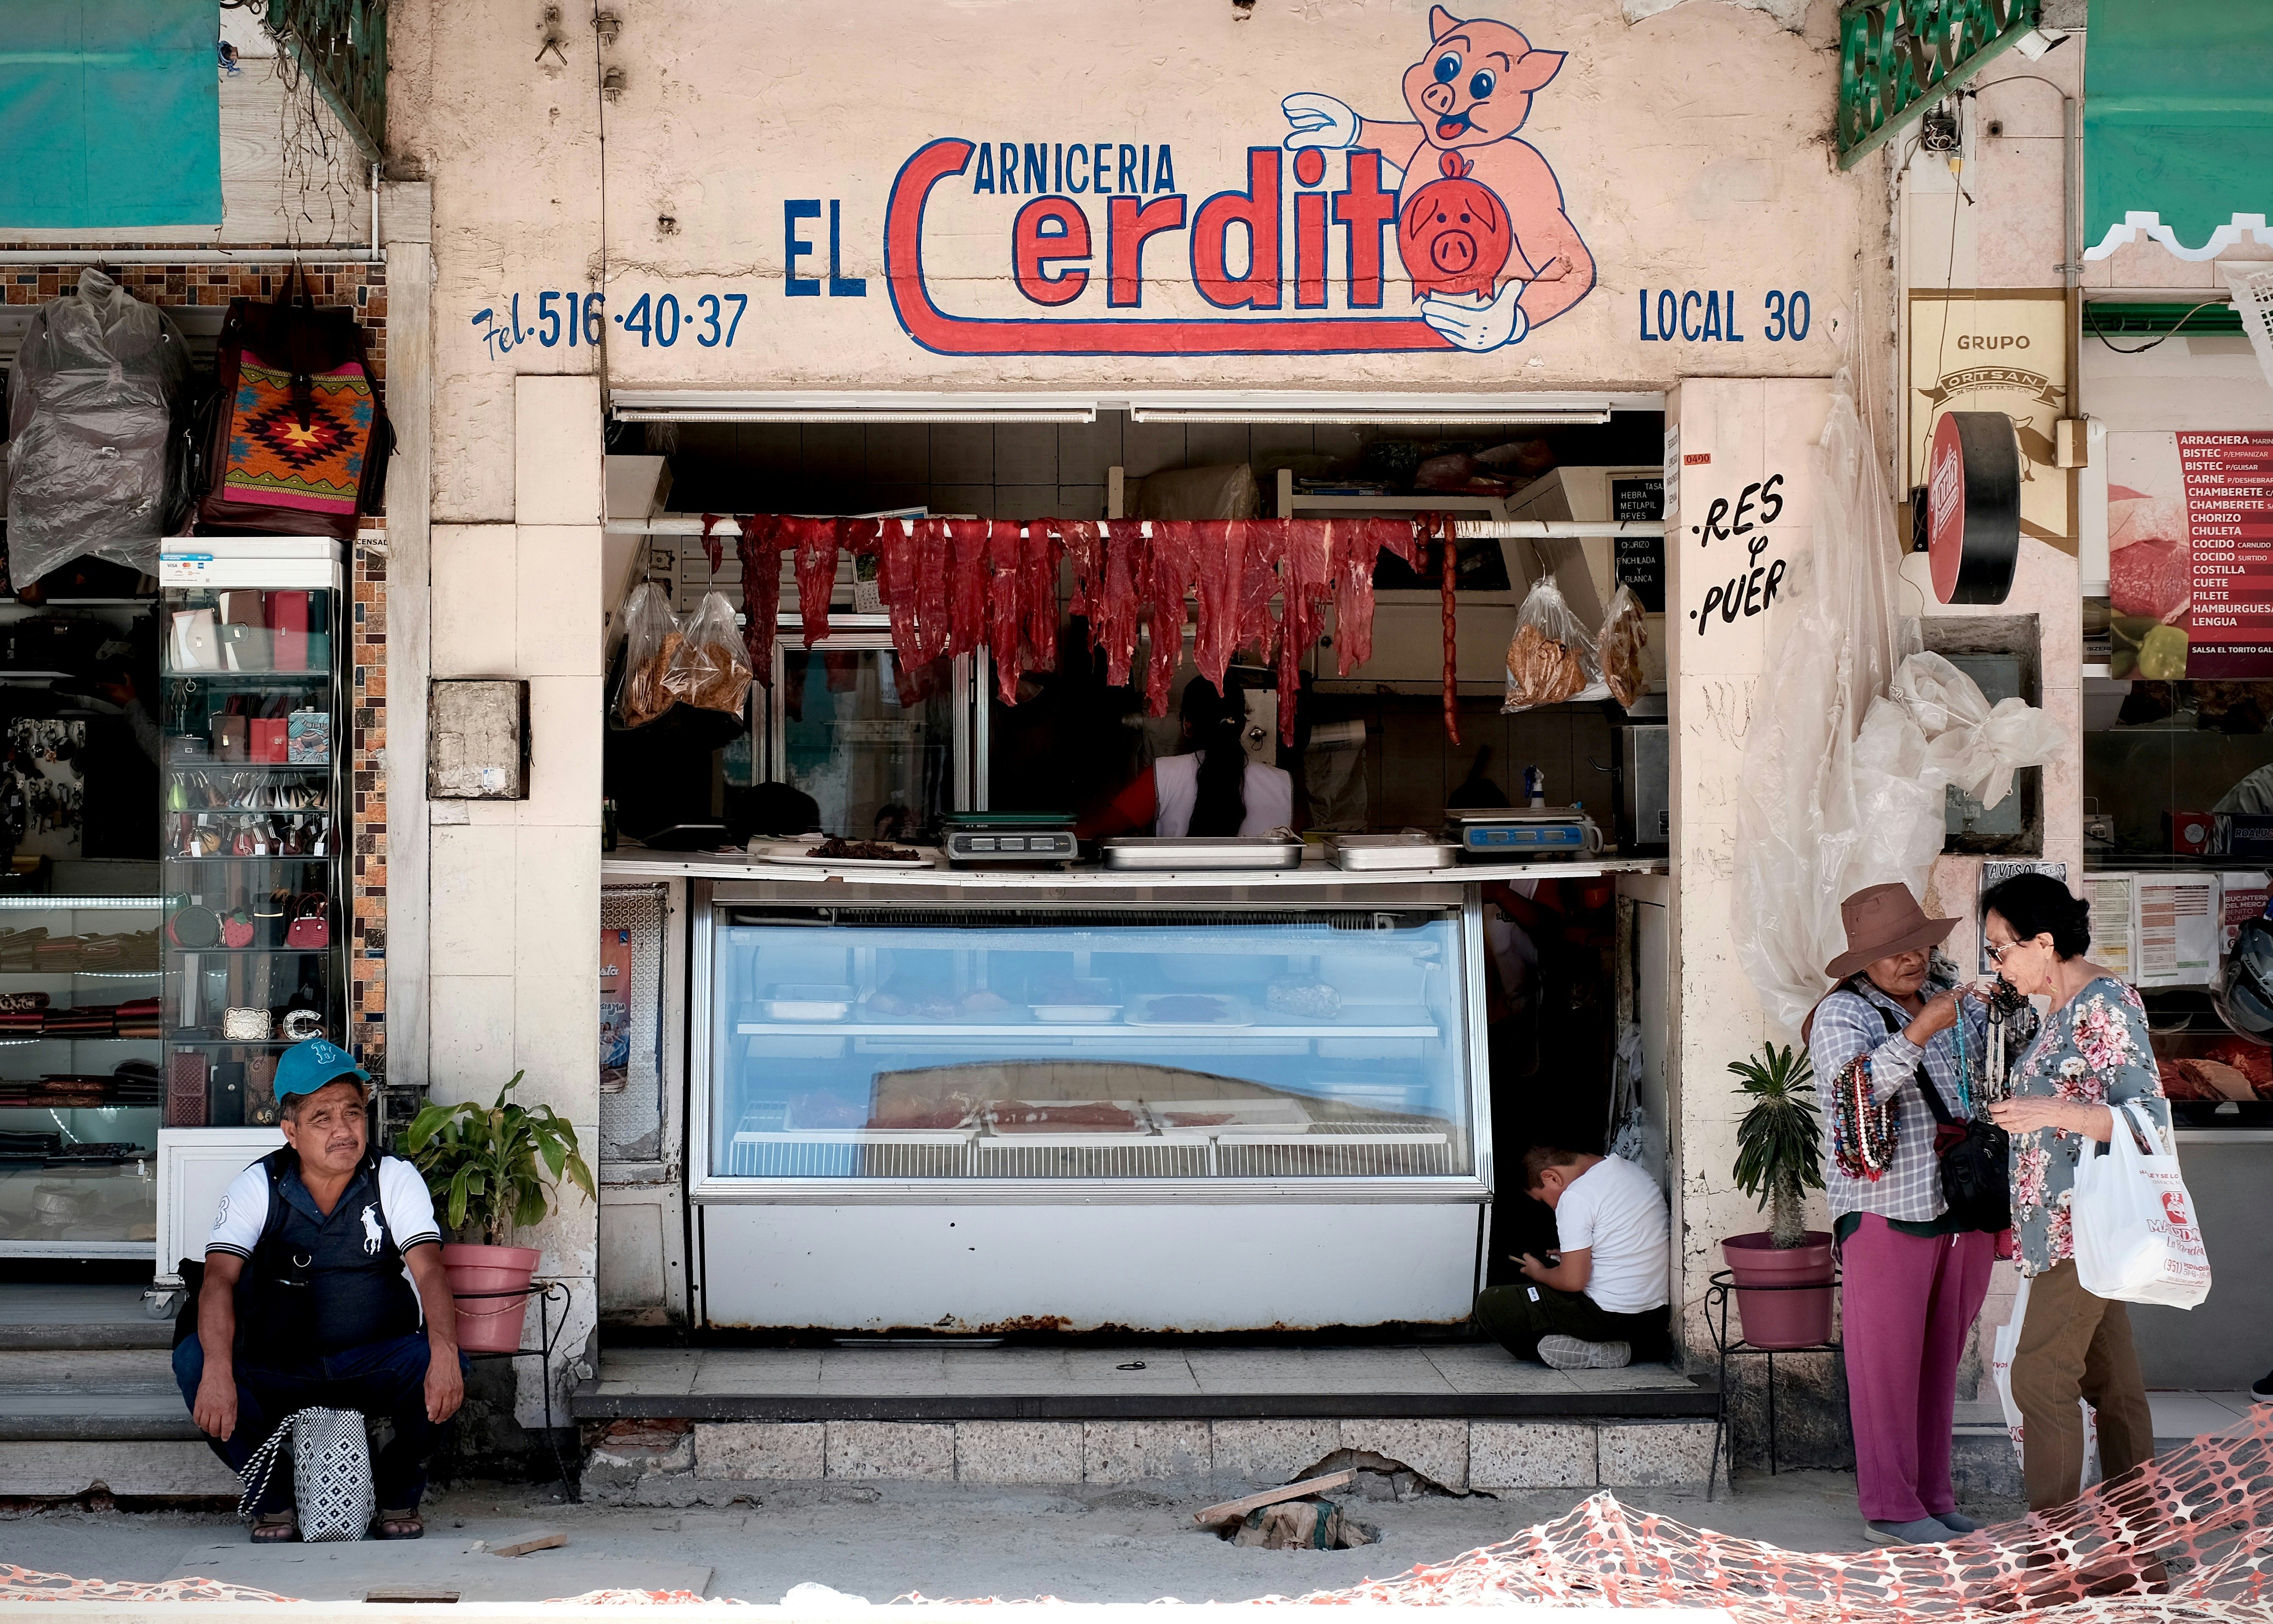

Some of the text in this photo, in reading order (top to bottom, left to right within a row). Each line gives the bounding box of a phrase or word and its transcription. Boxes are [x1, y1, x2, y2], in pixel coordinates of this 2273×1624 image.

[784, 198, 867, 297] EL
[1639, 289, 1810, 342] LOCAL 30
[1957, 335, 2031, 350] GRUPO
[1948, 371, 2038, 387] ORTSAN
[2180, 436, 2250, 445] ARRACHERA
[2183, 448, 2221, 458] BISTEC
[2185, 462, 2223, 470] BISTEC
[2187, 474, 2225, 484] CARNE
[1621, 491, 1647, 499] HEBRA
[2188, 487, 2263, 497] CHAMBERETE
[1620, 501, 1656, 509] METLAPIL
[2190, 501, 2265, 509] CHAMBERETE
[1621, 512, 1646, 520] REVES
[2191, 513, 2242, 523] CHORIZO
[2192, 526, 2242, 536] CHULETA
[2192, 539, 2235, 548] COCIDO
[1617, 556, 1656, 565] ENCHILADA
[2192, 552, 2235, 561] COCIDO
[2193, 565, 2246, 574] COSTILLA
[1625, 575, 1652, 583] BLANCA
[2193, 578, 2229, 587] CUETE
[2193, 591, 2229, 600] FILETE
[2192, 604, 2273, 613] HAMBURGUES
[2192, 617, 2237, 626] LENGUA
[311, 1041, 336, 1064] B
[213, 1195, 230, 1230] 3
[2164, 1258, 2182, 1274] (951)
